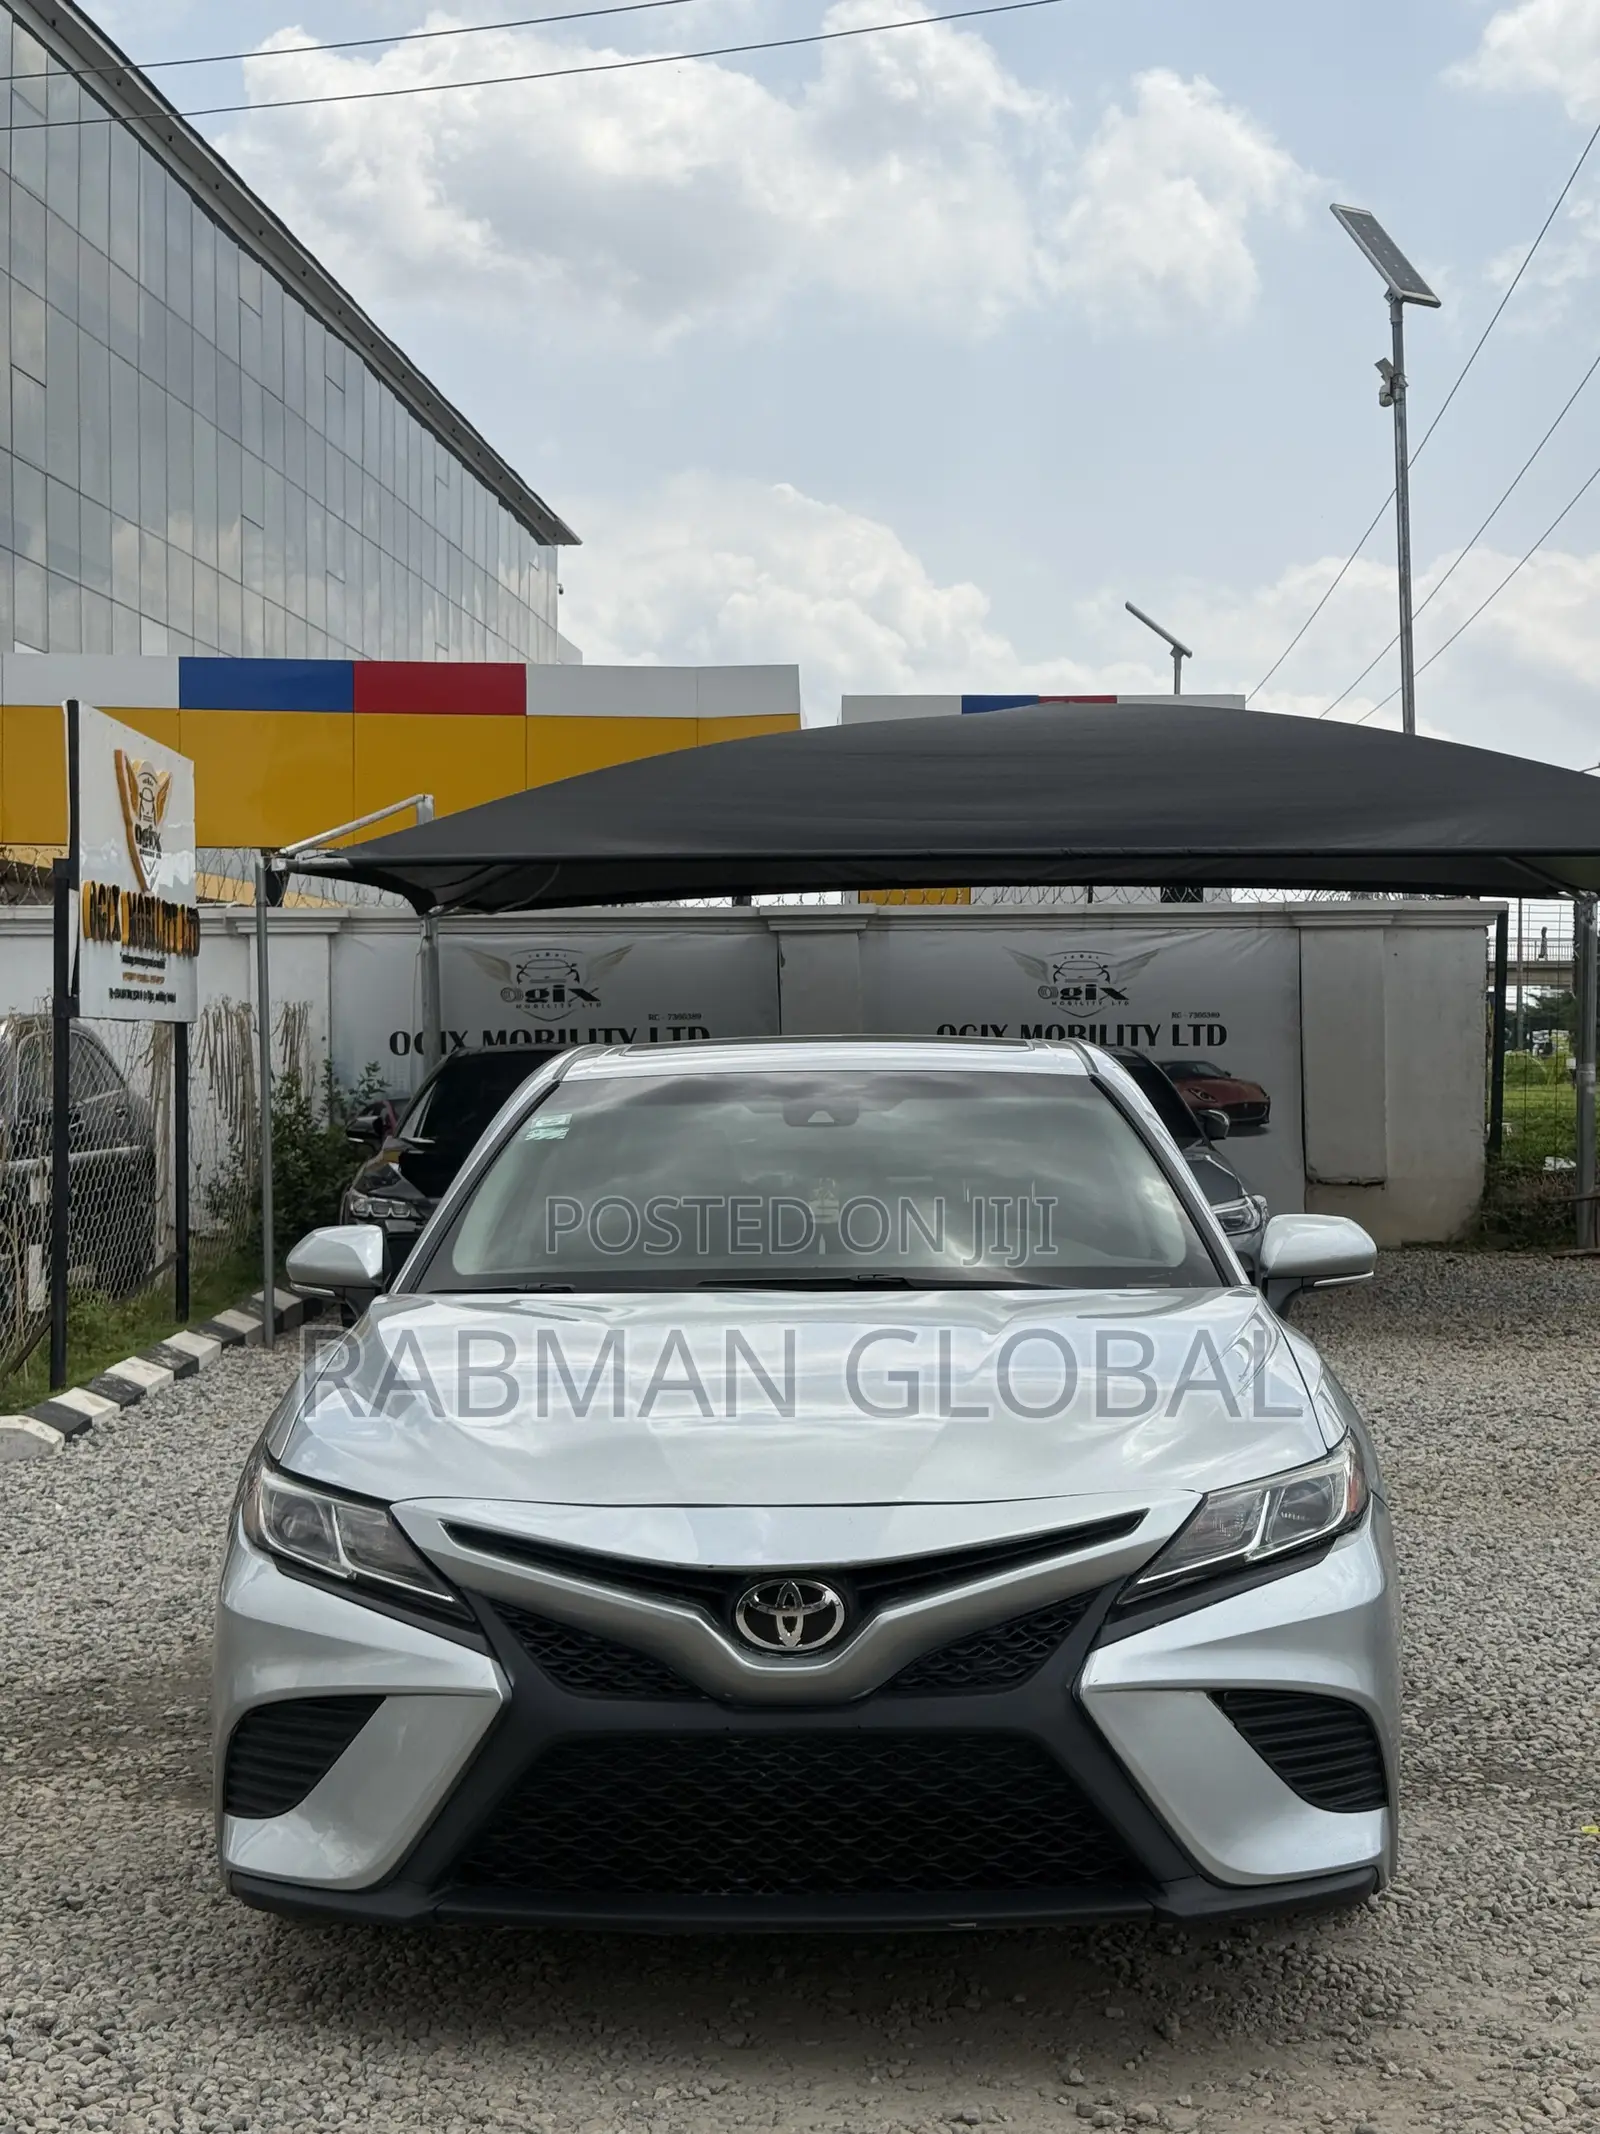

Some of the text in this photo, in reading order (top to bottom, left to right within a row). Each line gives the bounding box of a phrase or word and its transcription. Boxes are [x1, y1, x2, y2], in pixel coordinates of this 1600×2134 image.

[482, 1027, 637, 1047] MOBILITY
[1020, 1024, 1161, 1047] MOBILITY
[1171, 1024, 1228, 1047] LTD
